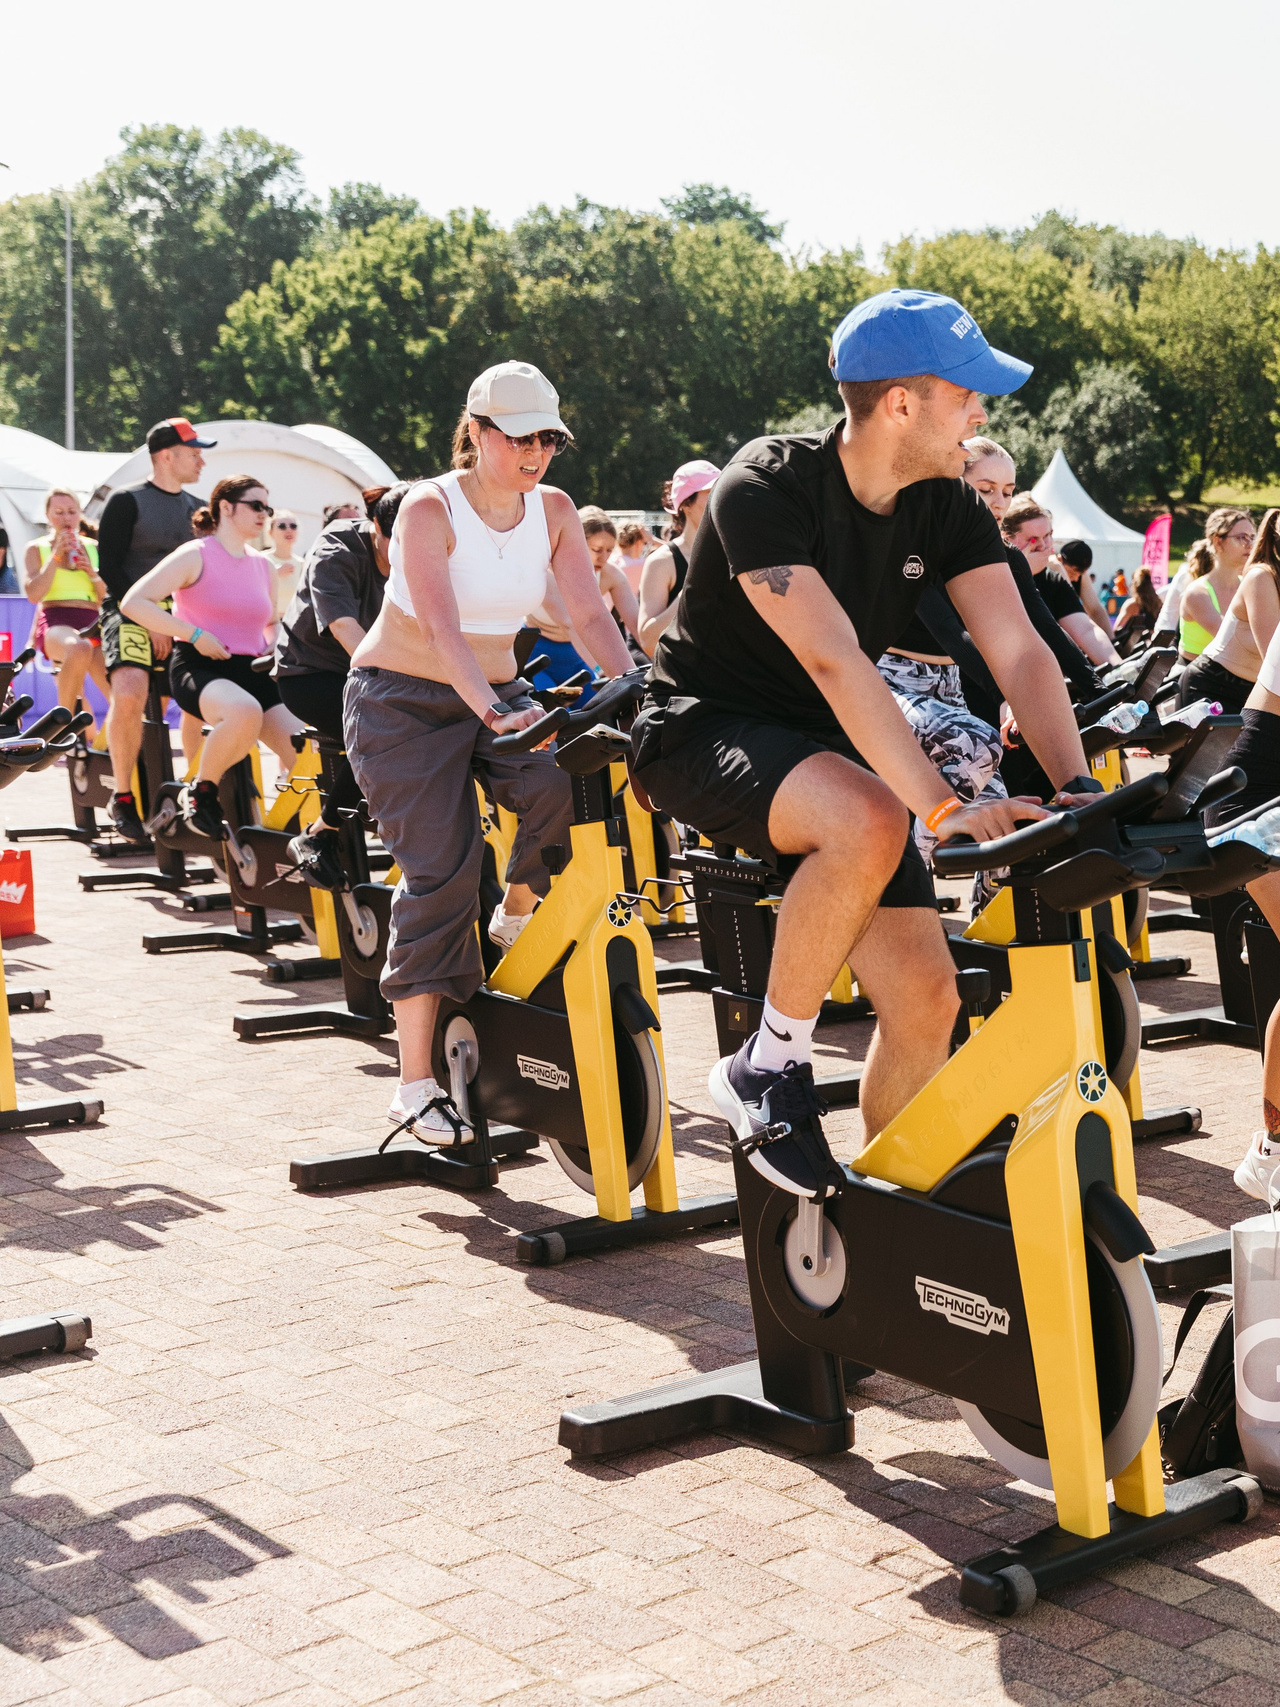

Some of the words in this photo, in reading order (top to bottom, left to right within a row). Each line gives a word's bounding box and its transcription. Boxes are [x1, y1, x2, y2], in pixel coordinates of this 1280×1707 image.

[950, 313, 973, 340] NEW
[734, 1011, 741, 1022] 4
[518, 1058, 568, 1085] TECHNOGYM
[917, 1281, 1006, 1328] TECHNOGYM
